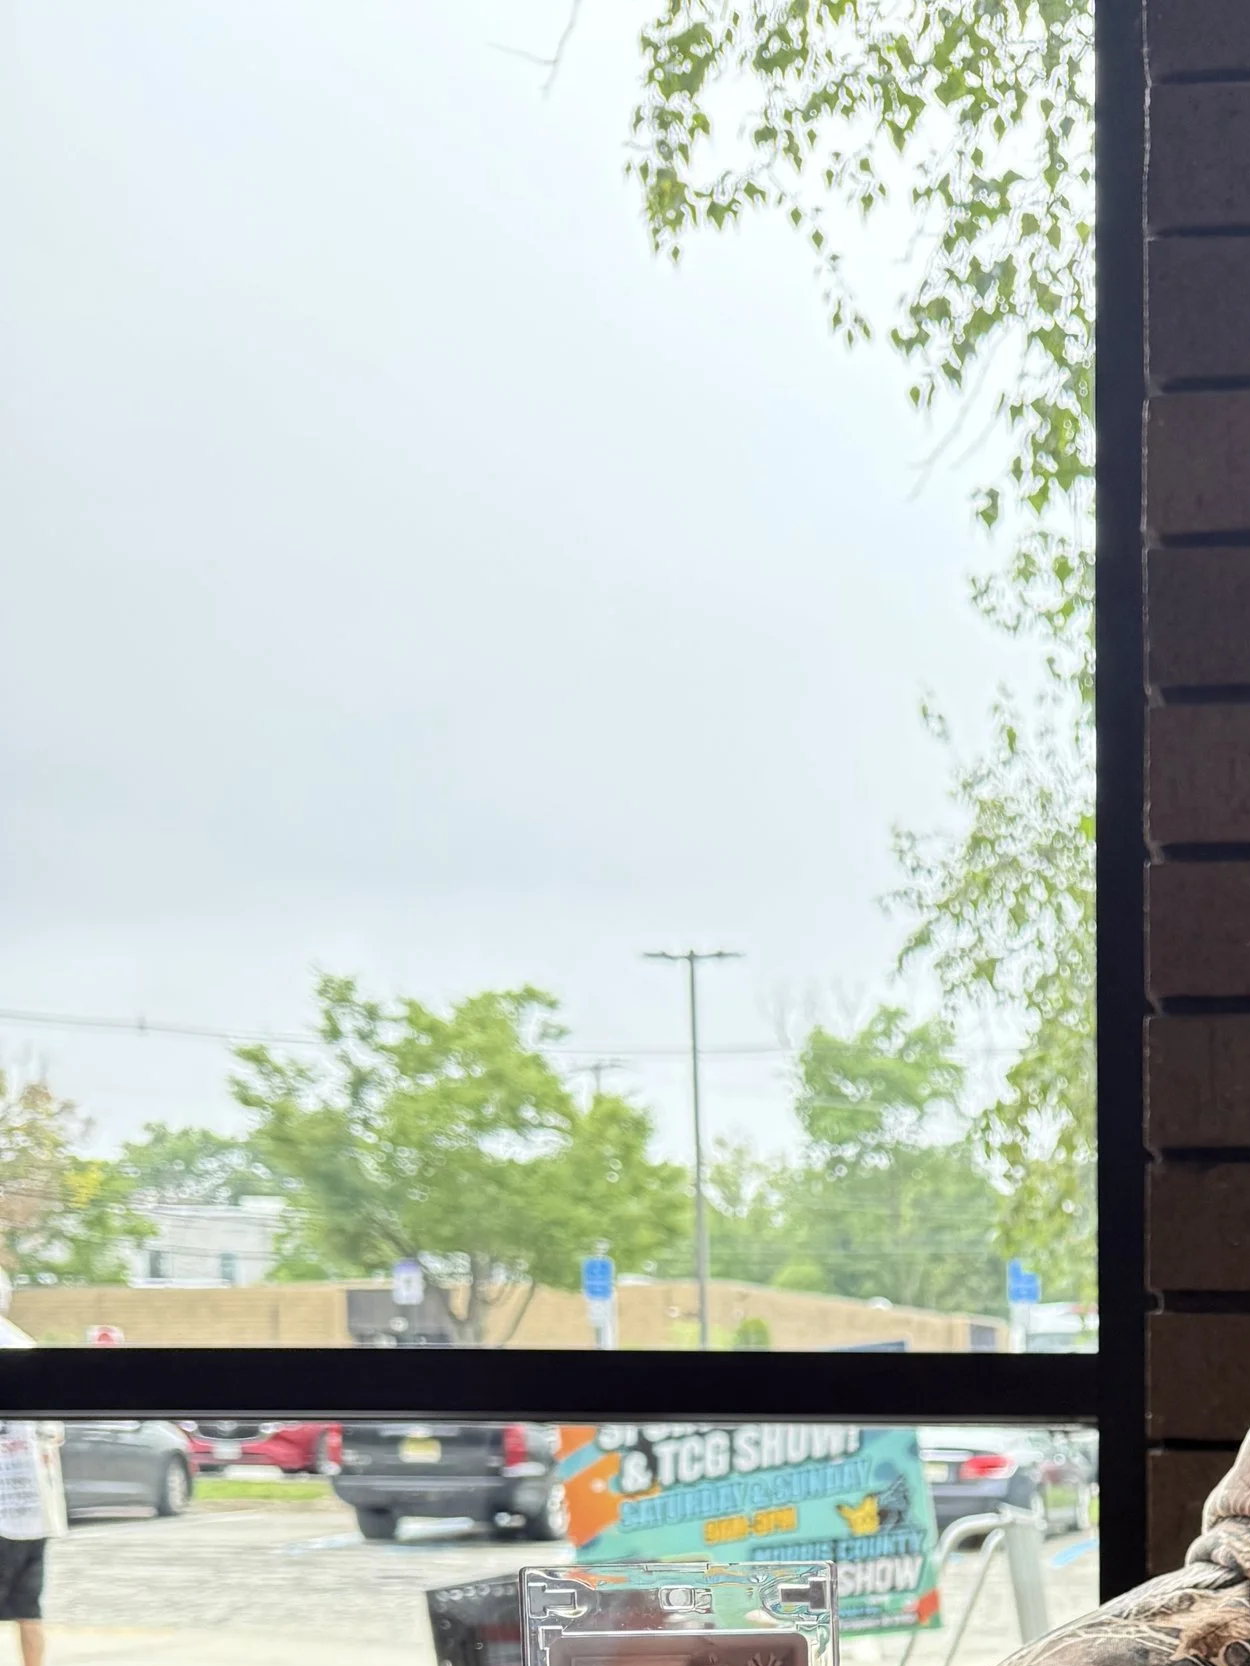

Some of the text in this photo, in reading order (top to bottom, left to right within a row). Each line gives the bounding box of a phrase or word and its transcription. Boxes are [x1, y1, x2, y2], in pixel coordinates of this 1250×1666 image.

[619, 1450, 652, 1493] &
[652, 1430, 730, 1487] TCG
[732, 1424, 861, 1473] SHOW!
[618, 1482, 748, 1529] SATURDAY
[773, 1456, 872, 1503] SUNDAY
[837, 1531, 926, 1562] COUNTY
[837, 1554, 925, 1597] SHOW
